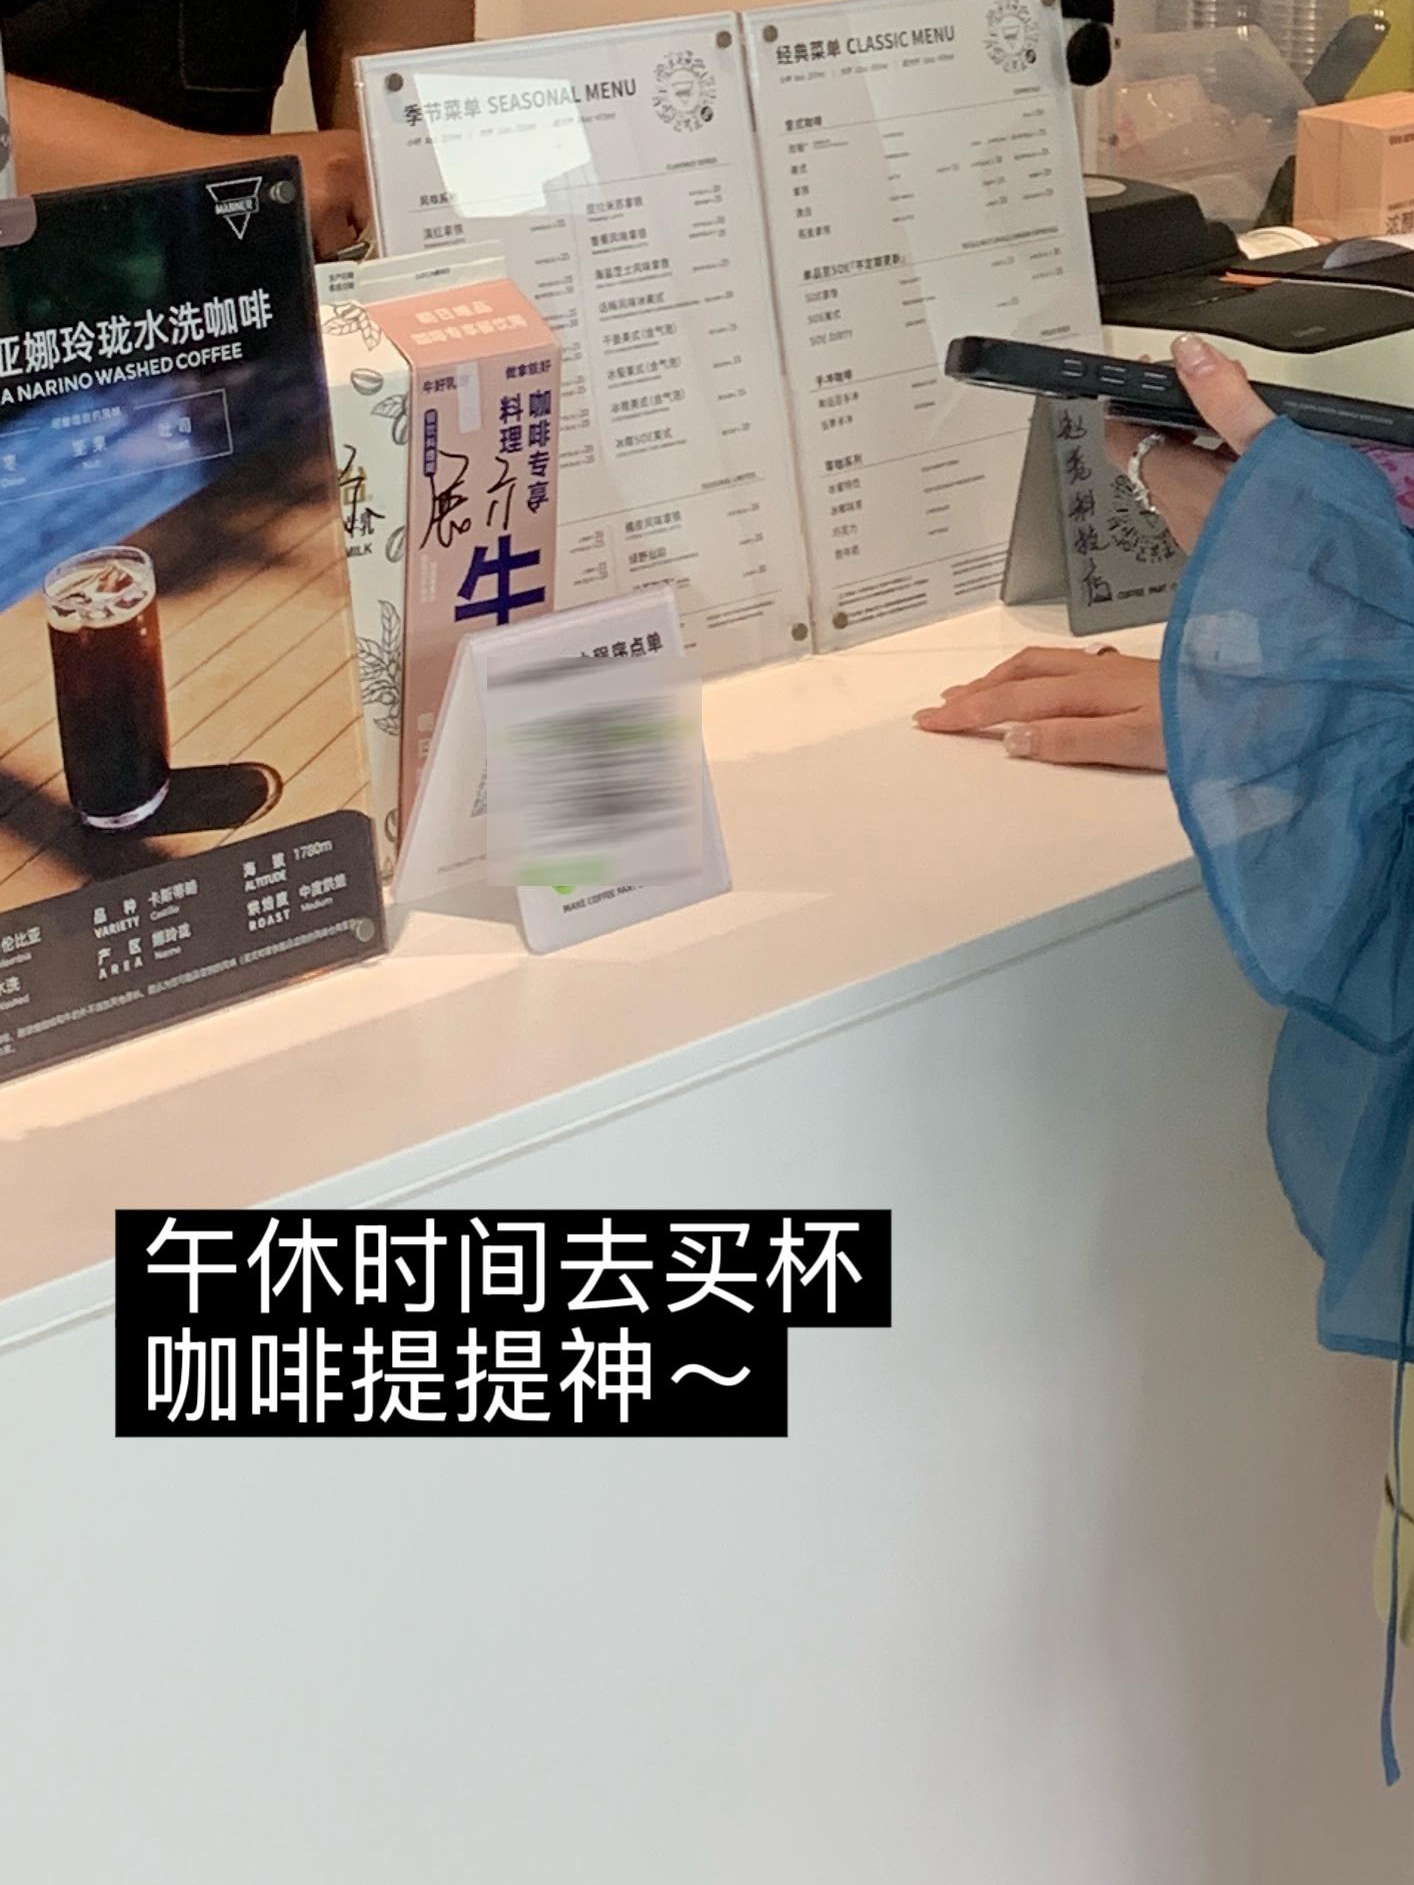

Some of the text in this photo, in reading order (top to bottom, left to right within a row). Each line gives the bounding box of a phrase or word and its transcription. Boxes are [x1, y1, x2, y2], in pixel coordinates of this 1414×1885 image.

[775, 25, 956, 65] 经典菜单 CLASSIC MENU
[403, 78, 637, 127] 季节菜单 SEASONAL MENU
[17, 372, 94, 403] NARINO
[94, 356, 174, 386] WASHED
[176, 341, 244, 370] COFFEE
[499, 392, 524, 455] 料理
[528, 388, 553, 515] 咖啡专享
[454, 533, 546, 627] 牛
[248, 908, 291, 932] ROAST
